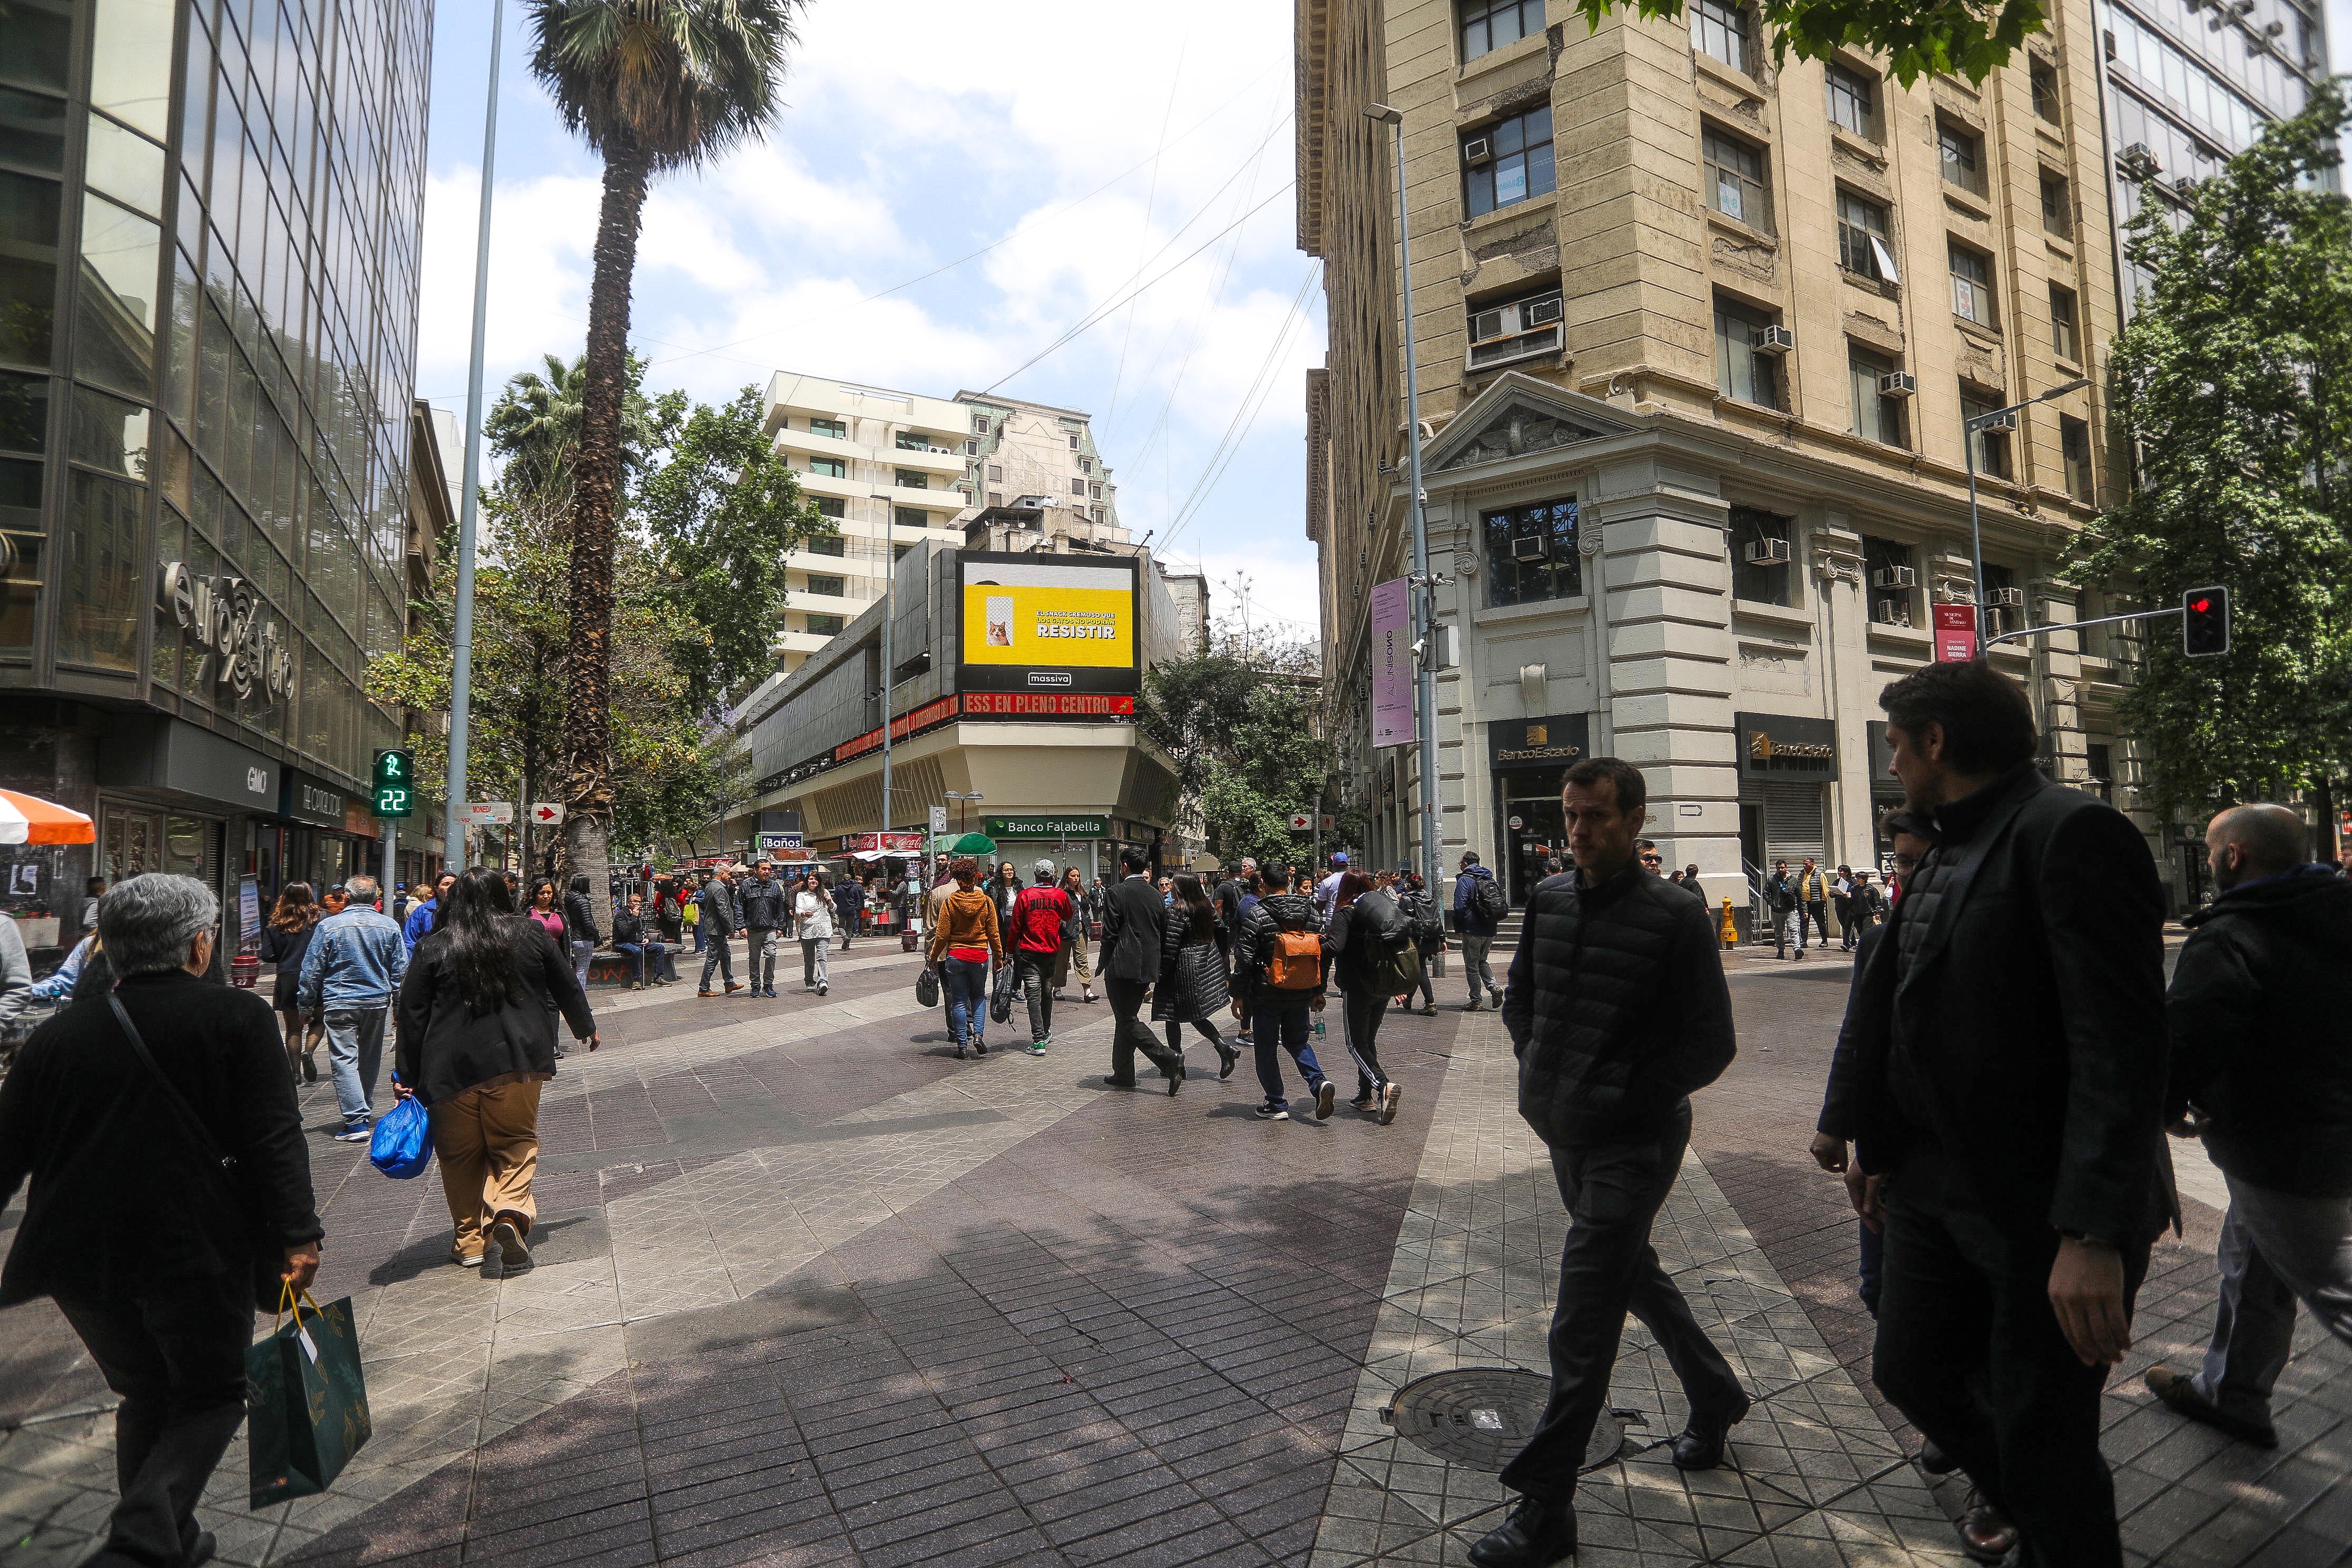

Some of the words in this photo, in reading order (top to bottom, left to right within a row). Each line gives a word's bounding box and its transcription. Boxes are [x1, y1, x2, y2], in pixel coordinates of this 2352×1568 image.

[1037, 624, 1115, 639] RESISTIR
[1388, 682, 1395, 696] AL
[966, 695, 990, 712] ESS
[995, 695, 1011, 712] EN
[1016, 696, 1056, 713] PLENO
[1498, 746, 1579, 760] BancoEstado
[1769, 741, 1833, 758] BancoEstado
[380, 790, 405, 811] 22
[1008, 822, 1043, 832] Banco
[1047, 822, 1100, 831] Falabella
[768, 838, 800, 847] Baños
[1031, 898, 1059, 910] BULLS
